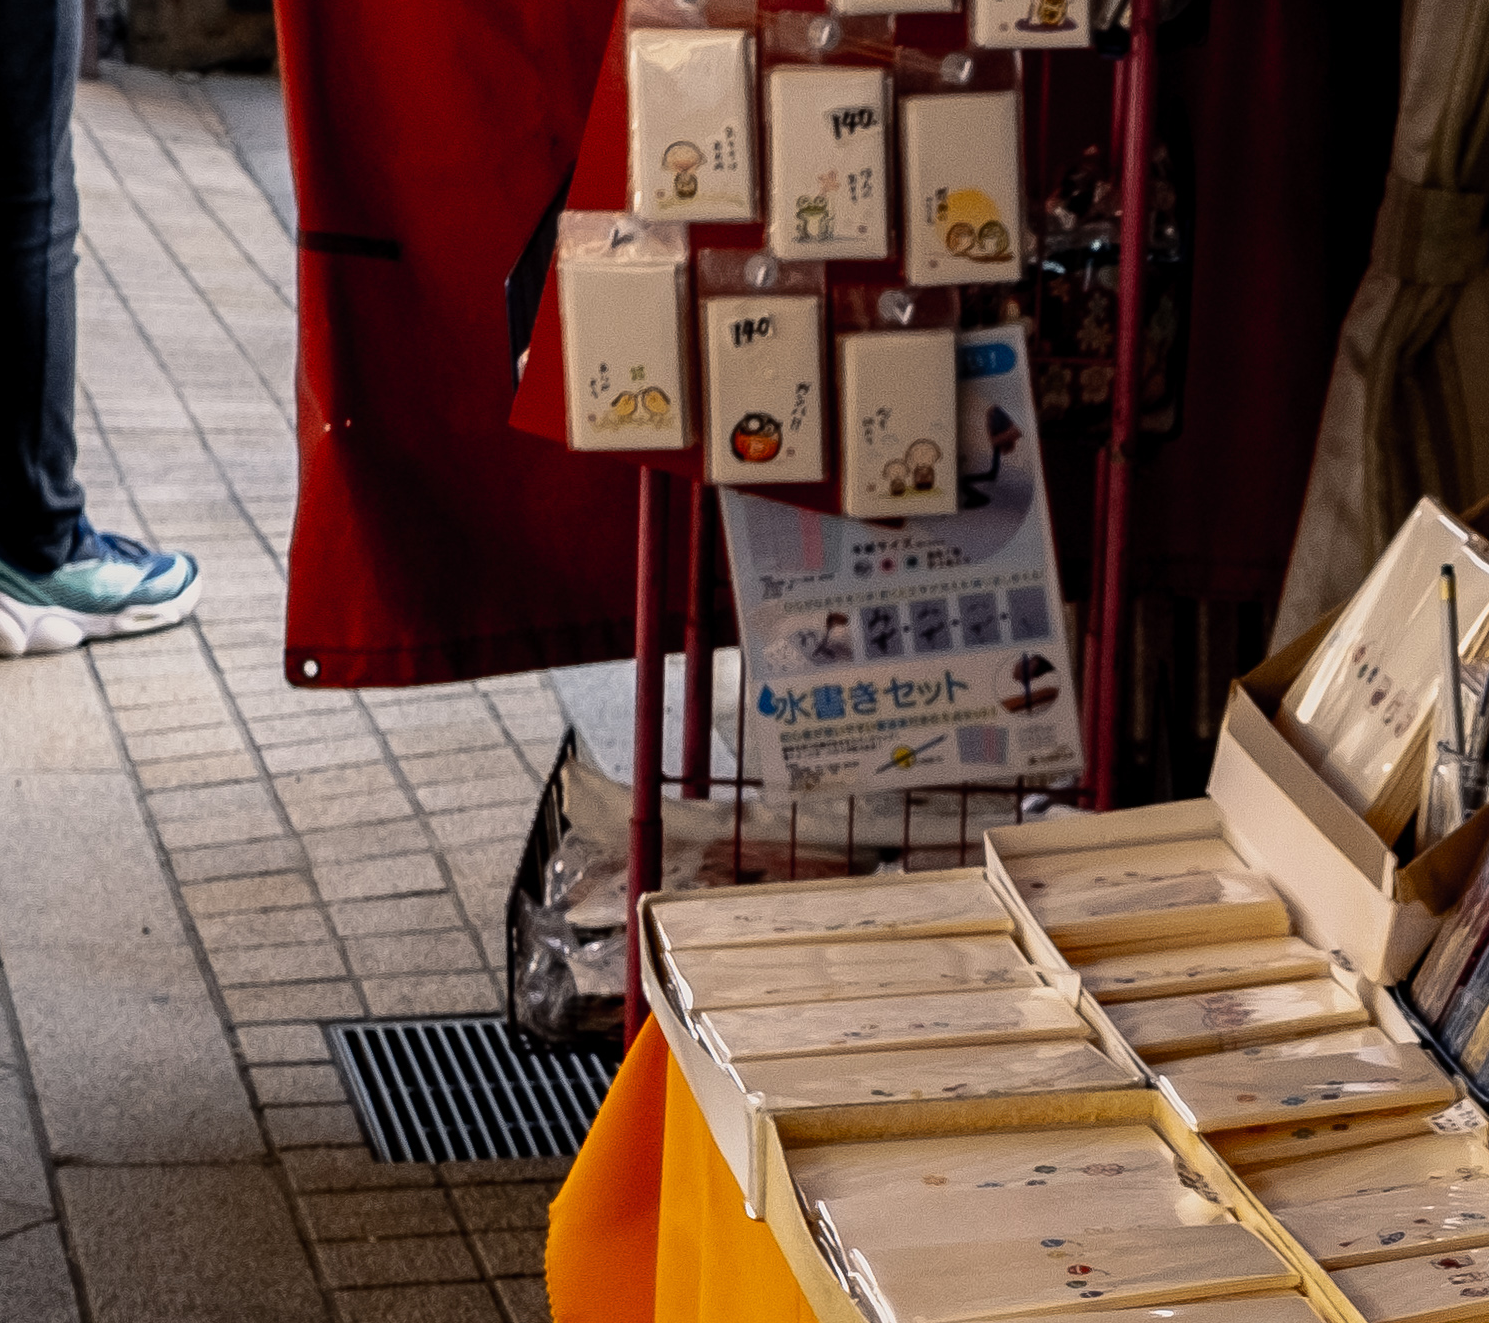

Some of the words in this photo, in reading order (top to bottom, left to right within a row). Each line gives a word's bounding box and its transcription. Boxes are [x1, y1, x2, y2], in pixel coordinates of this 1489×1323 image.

[826, 106, 879, 139] 140
[729, 316, 770, 348] 140
[775, 671, 969, 725] 水書きセット
